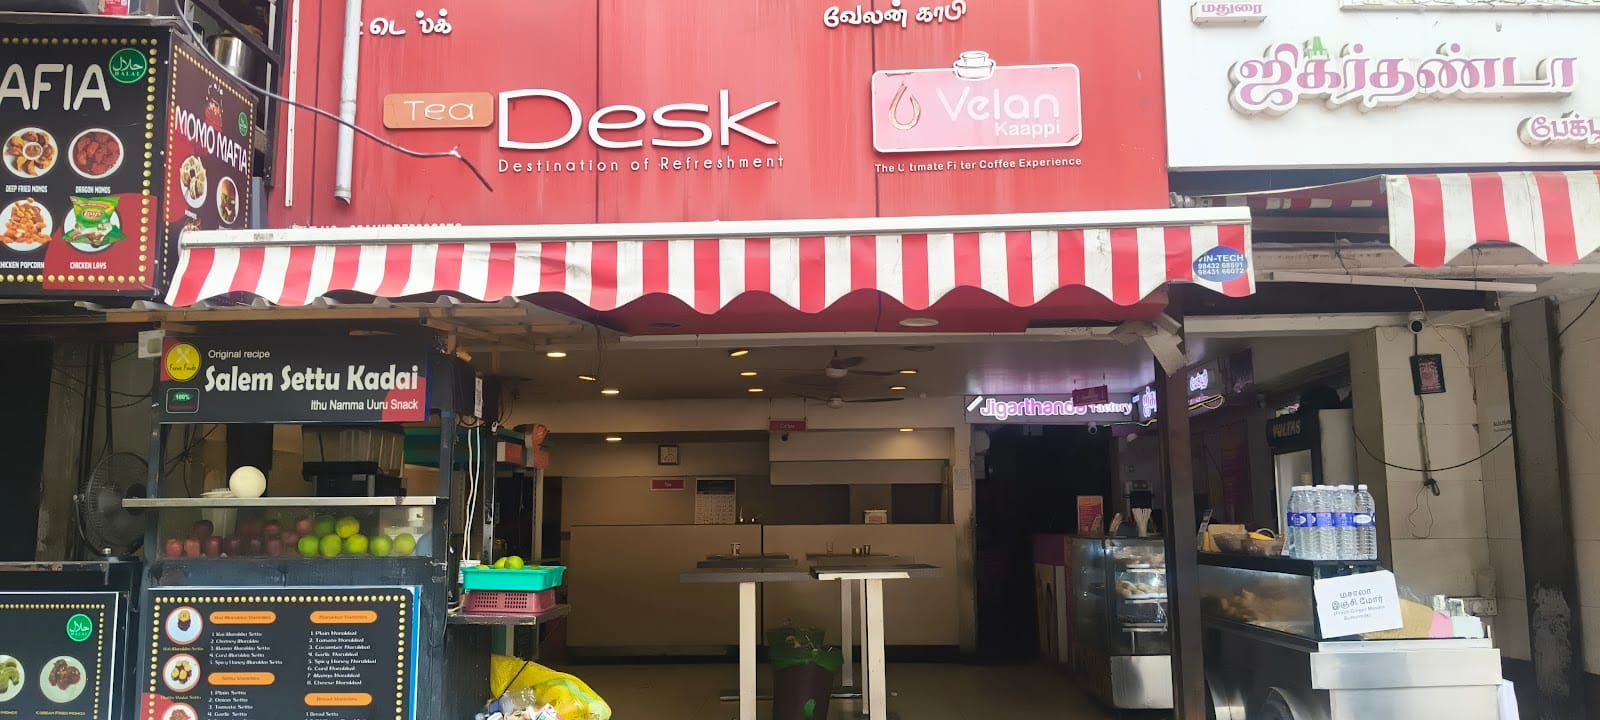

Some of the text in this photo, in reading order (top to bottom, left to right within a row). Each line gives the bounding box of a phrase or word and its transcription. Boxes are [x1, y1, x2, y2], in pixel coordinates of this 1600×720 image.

[113, 57, 144, 71] حلال
[1238, 42, 1578, 106] ஜிகர்தண்டா
[936, 87, 1060, 121] Velan
[403, 88, 780, 149] Tea Desk
[995, 120, 1061, 140] Kaappi
[175, 105, 215, 155] MOMO
[217, 131, 249, 175] MAFIA
[499, 155, 785, 173] Destination of Refreshment
[875, 157, 1082, 174] The Utimate Fiter Coffee Experience
[18, 185, 31, 193] FRIED
[208, 349, 270, 360] Original recipe
[205, 364, 419, 392] Salem Settu Kadai
[311, 399, 418, 410] Ithu Namma Uuru Snack
